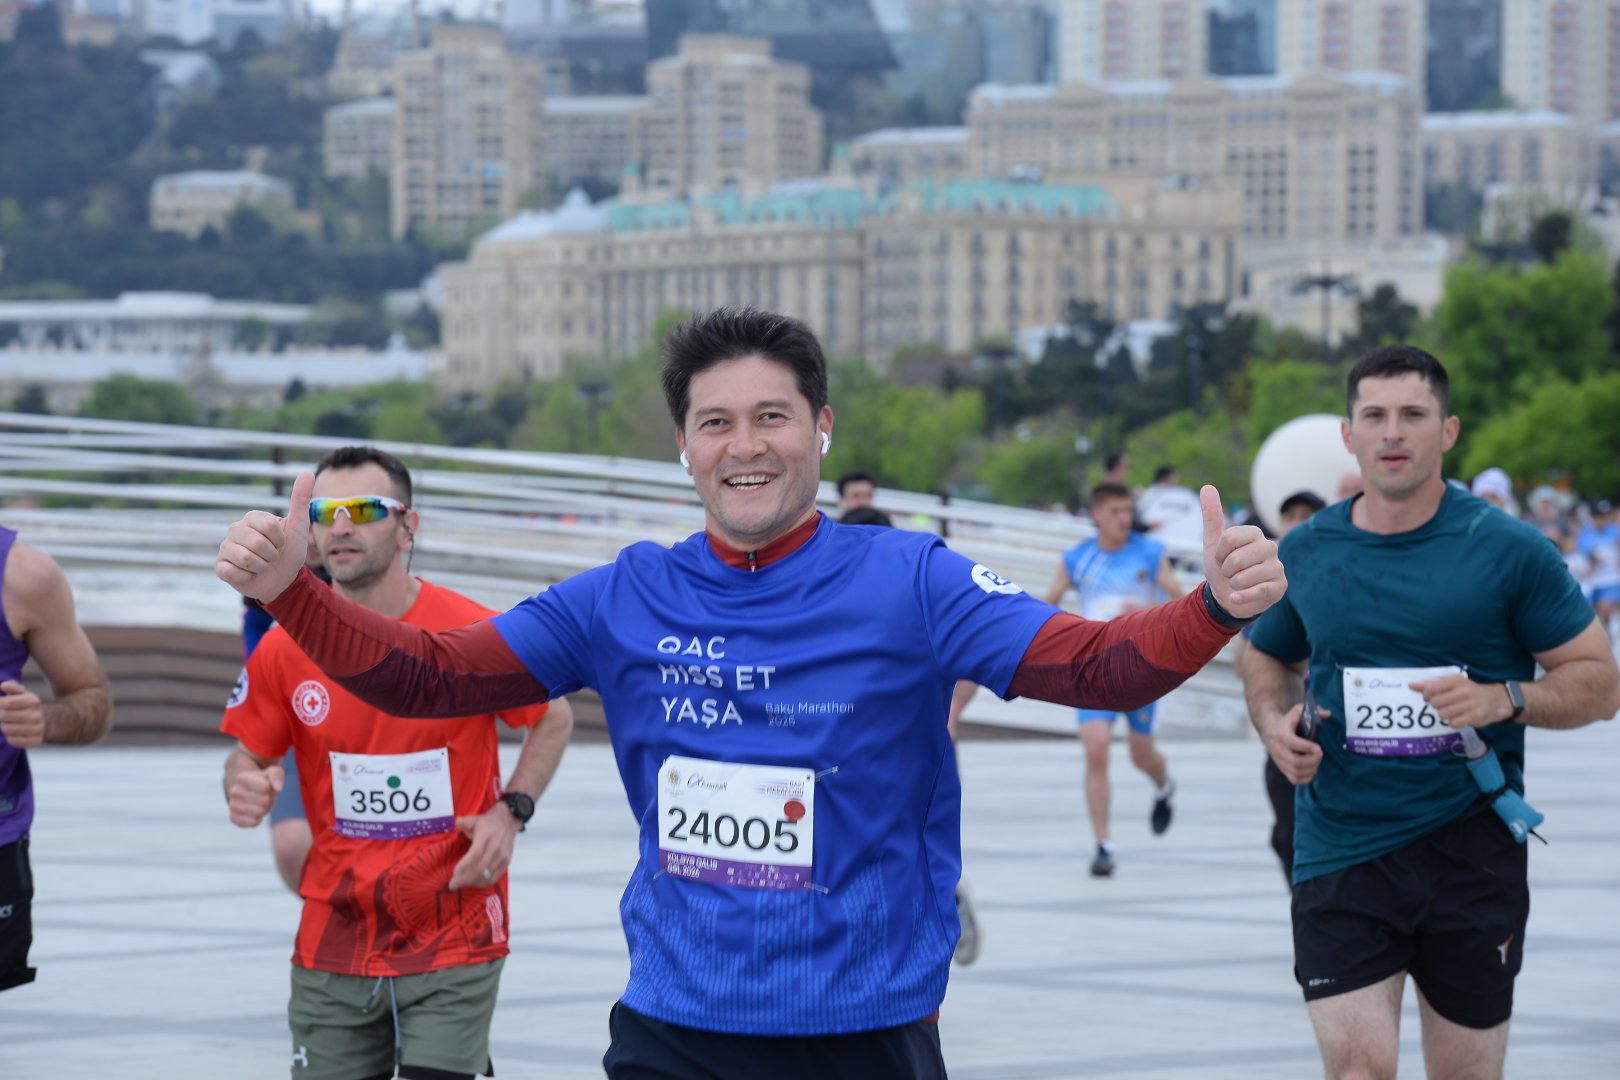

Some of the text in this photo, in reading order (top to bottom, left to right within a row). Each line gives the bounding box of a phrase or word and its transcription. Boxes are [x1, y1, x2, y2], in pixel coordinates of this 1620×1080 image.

[657, 636, 726, 660] QAÇ
[736, 665, 776, 691] ET
[661, 697, 743, 729] YAŞA
[765, 700, 854, 715] Baku Marathon
[1357, 704, 1452, 730] 2336
[350, 788, 431, 814] 3506
[667, 807, 799, 854] 24005
